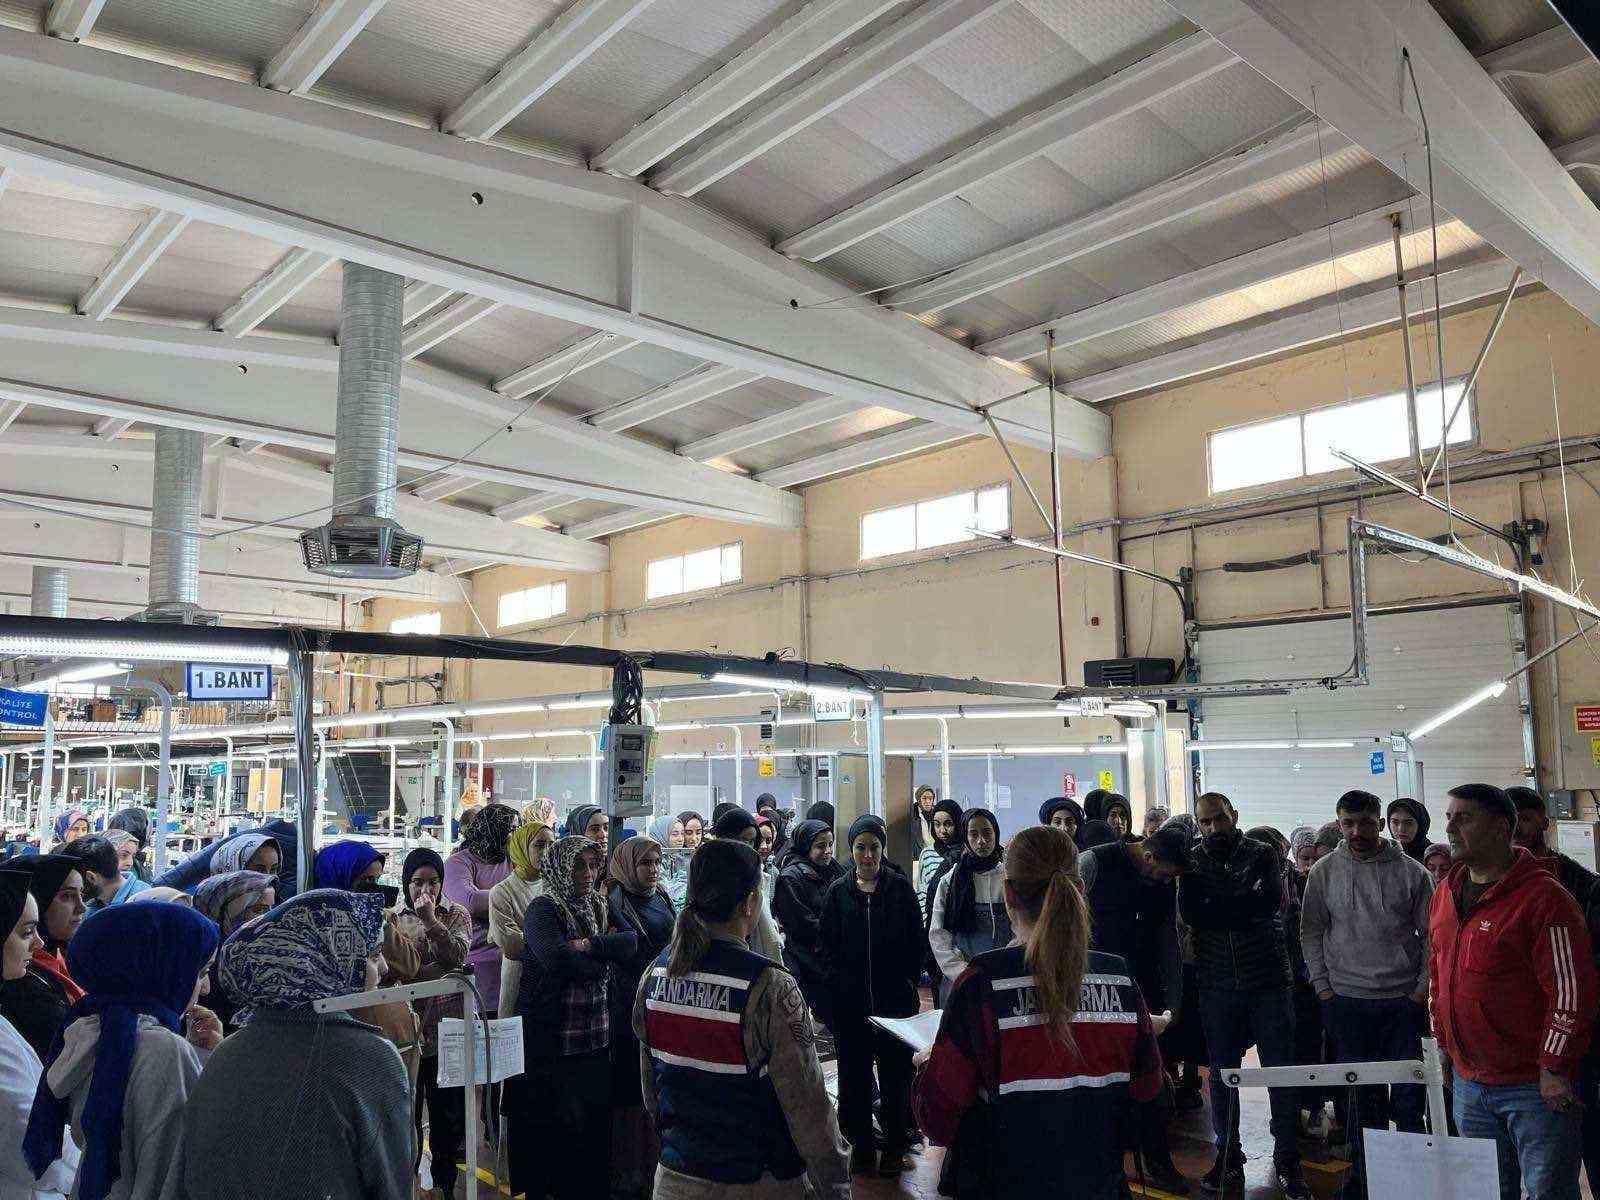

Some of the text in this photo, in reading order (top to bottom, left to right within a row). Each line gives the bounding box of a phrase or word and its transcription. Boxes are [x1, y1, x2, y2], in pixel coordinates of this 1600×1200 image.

[195, 671, 265, 689] 1.BANT
[0, 709, 39, 719] ONTROL
[651, 976, 730, 1010] JANDARMA
[1012, 984, 1122, 1014] JARMA
